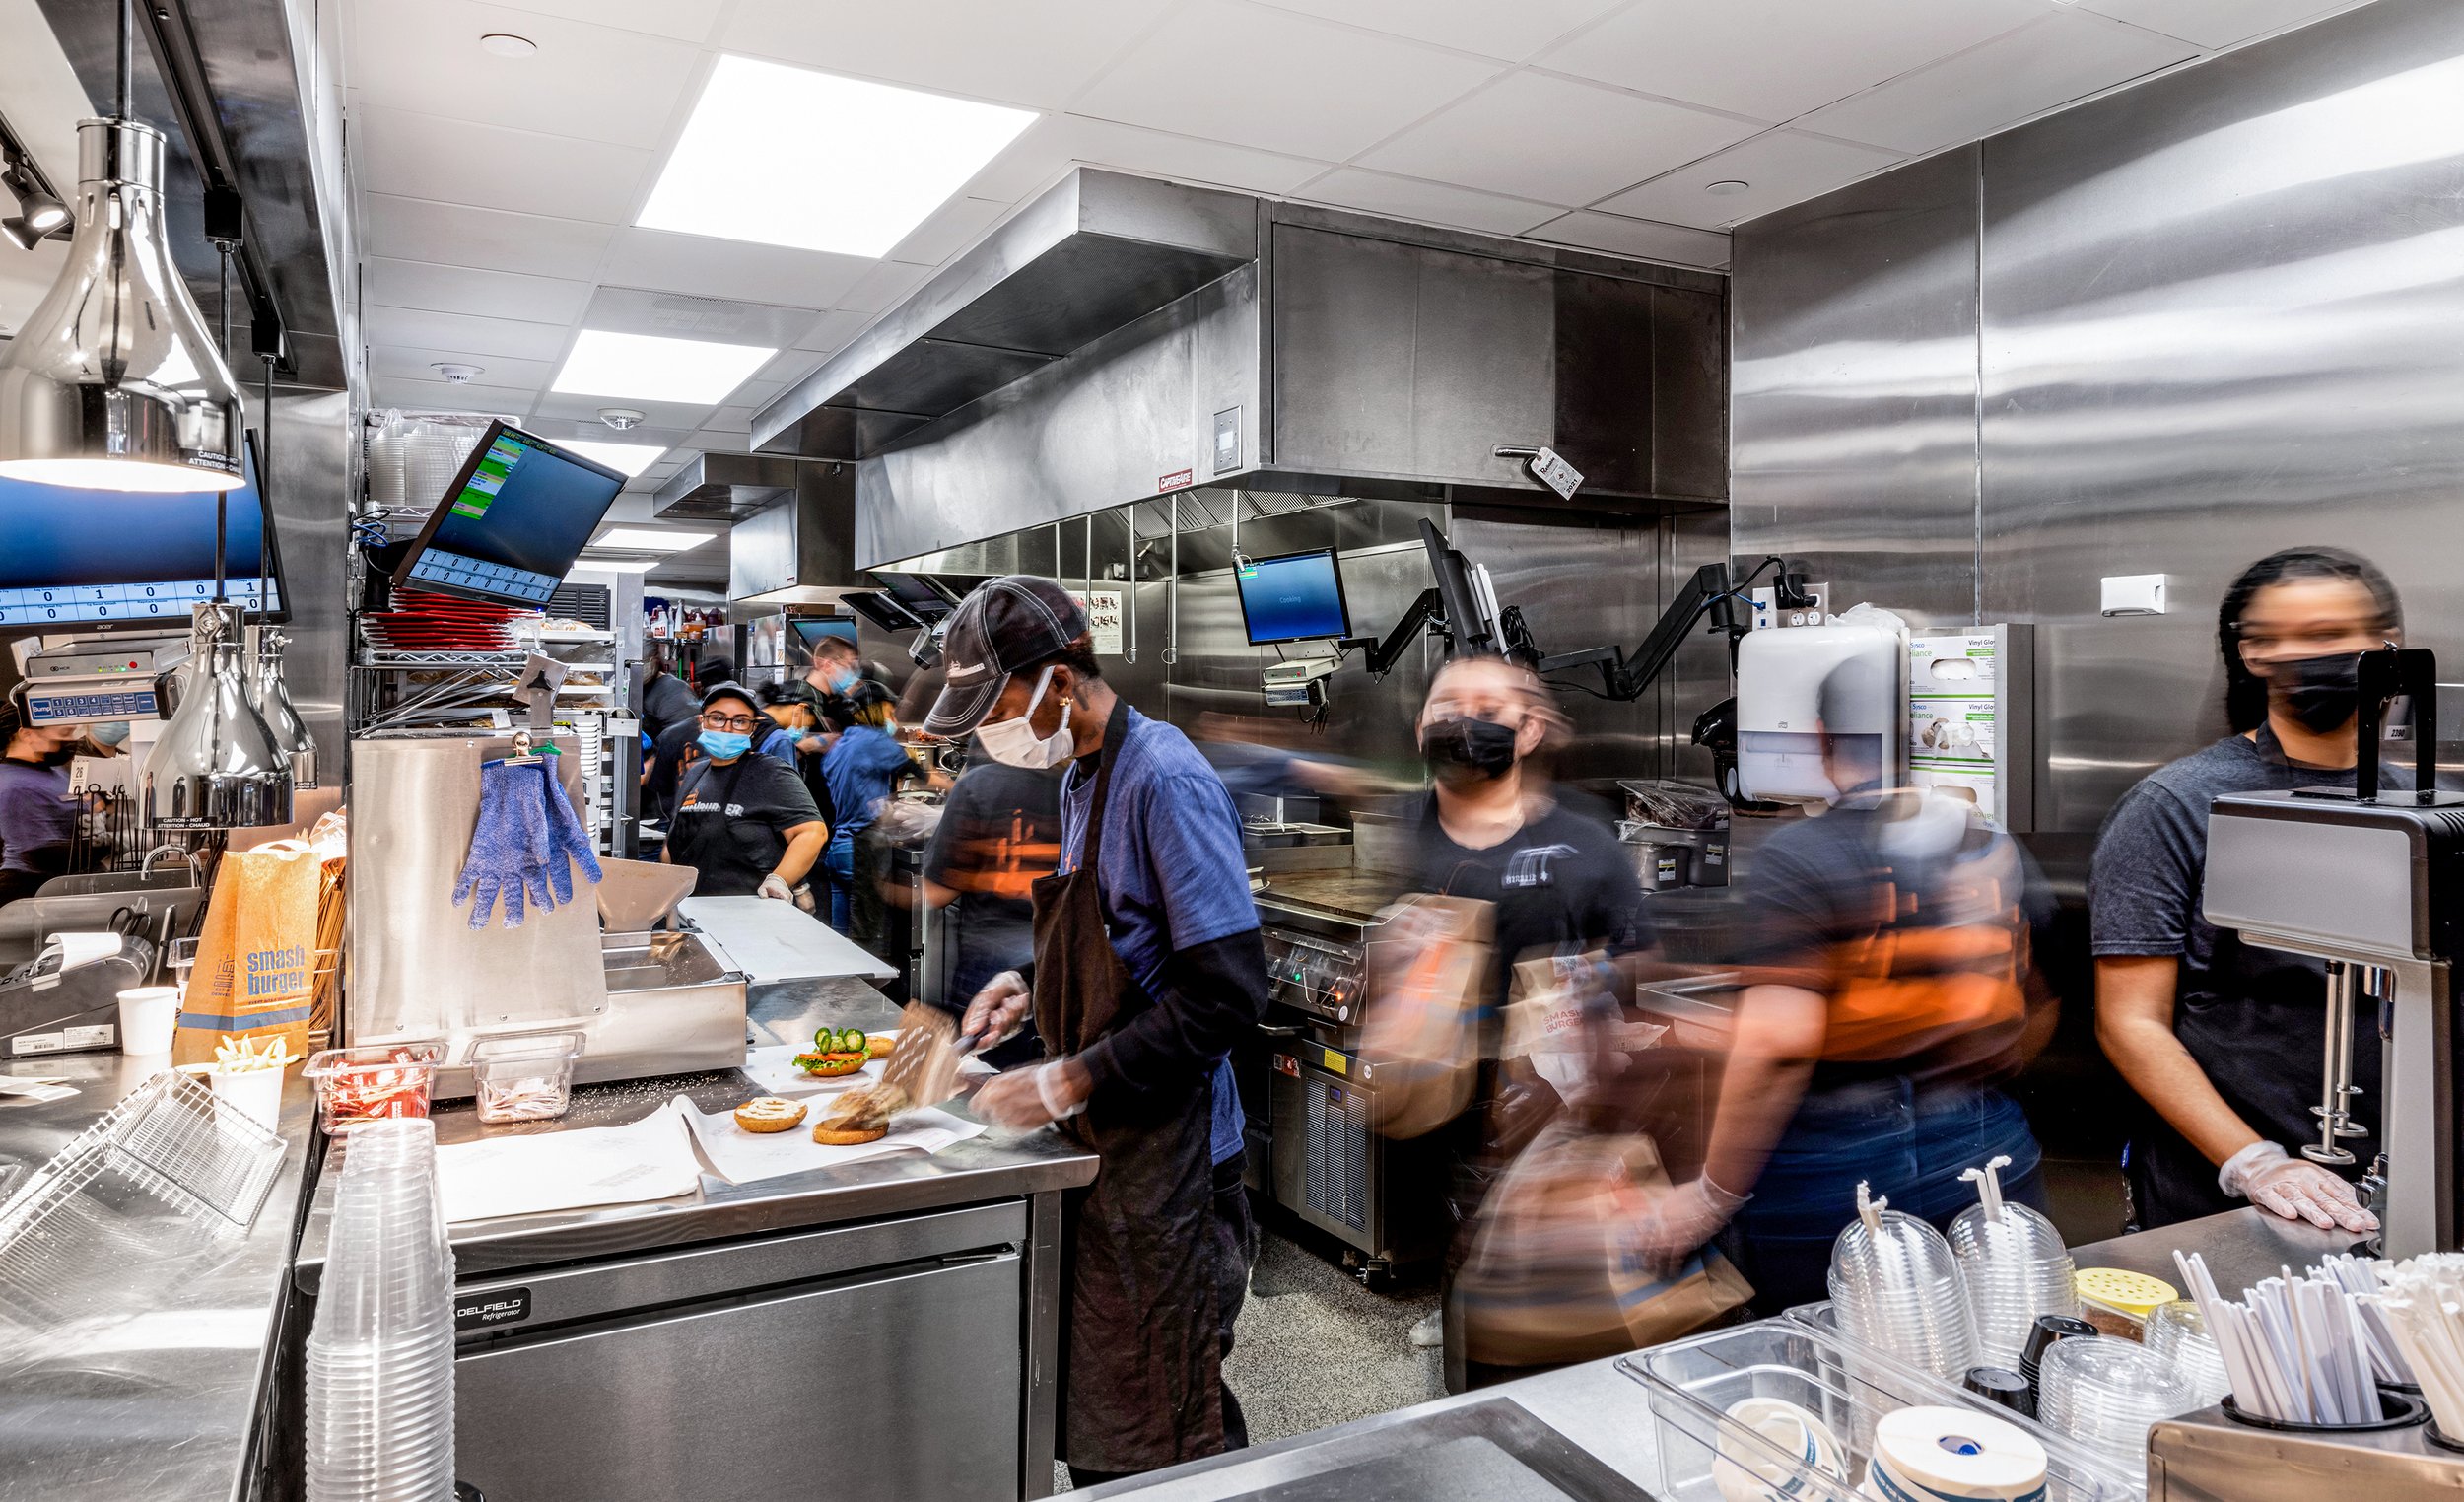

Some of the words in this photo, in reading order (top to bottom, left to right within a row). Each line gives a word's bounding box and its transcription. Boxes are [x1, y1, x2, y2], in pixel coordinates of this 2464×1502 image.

[198, 451, 226, 461] CAUTION
[189, 458, 226, 469] ATTENTION
[146, 587, 155, 596] 0
[196, 584, 205, 594] 0
[246, 582, 255, 592] 1
[44, 592, 52, 601] 0
[96, 589, 103, 599] 1
[150, 603, 158, 613] 0
[249, 599, 258, 609] 0
[47, 609, 56, 618] 0
[99, 606, 107, 616] 0
[247, 944, 305, 972] smash
[248, 971, 305, 996] burger
[457, 1299, 521, 1317] DELFIELD
[482, 1309, 520, 1321] Refrigerator
